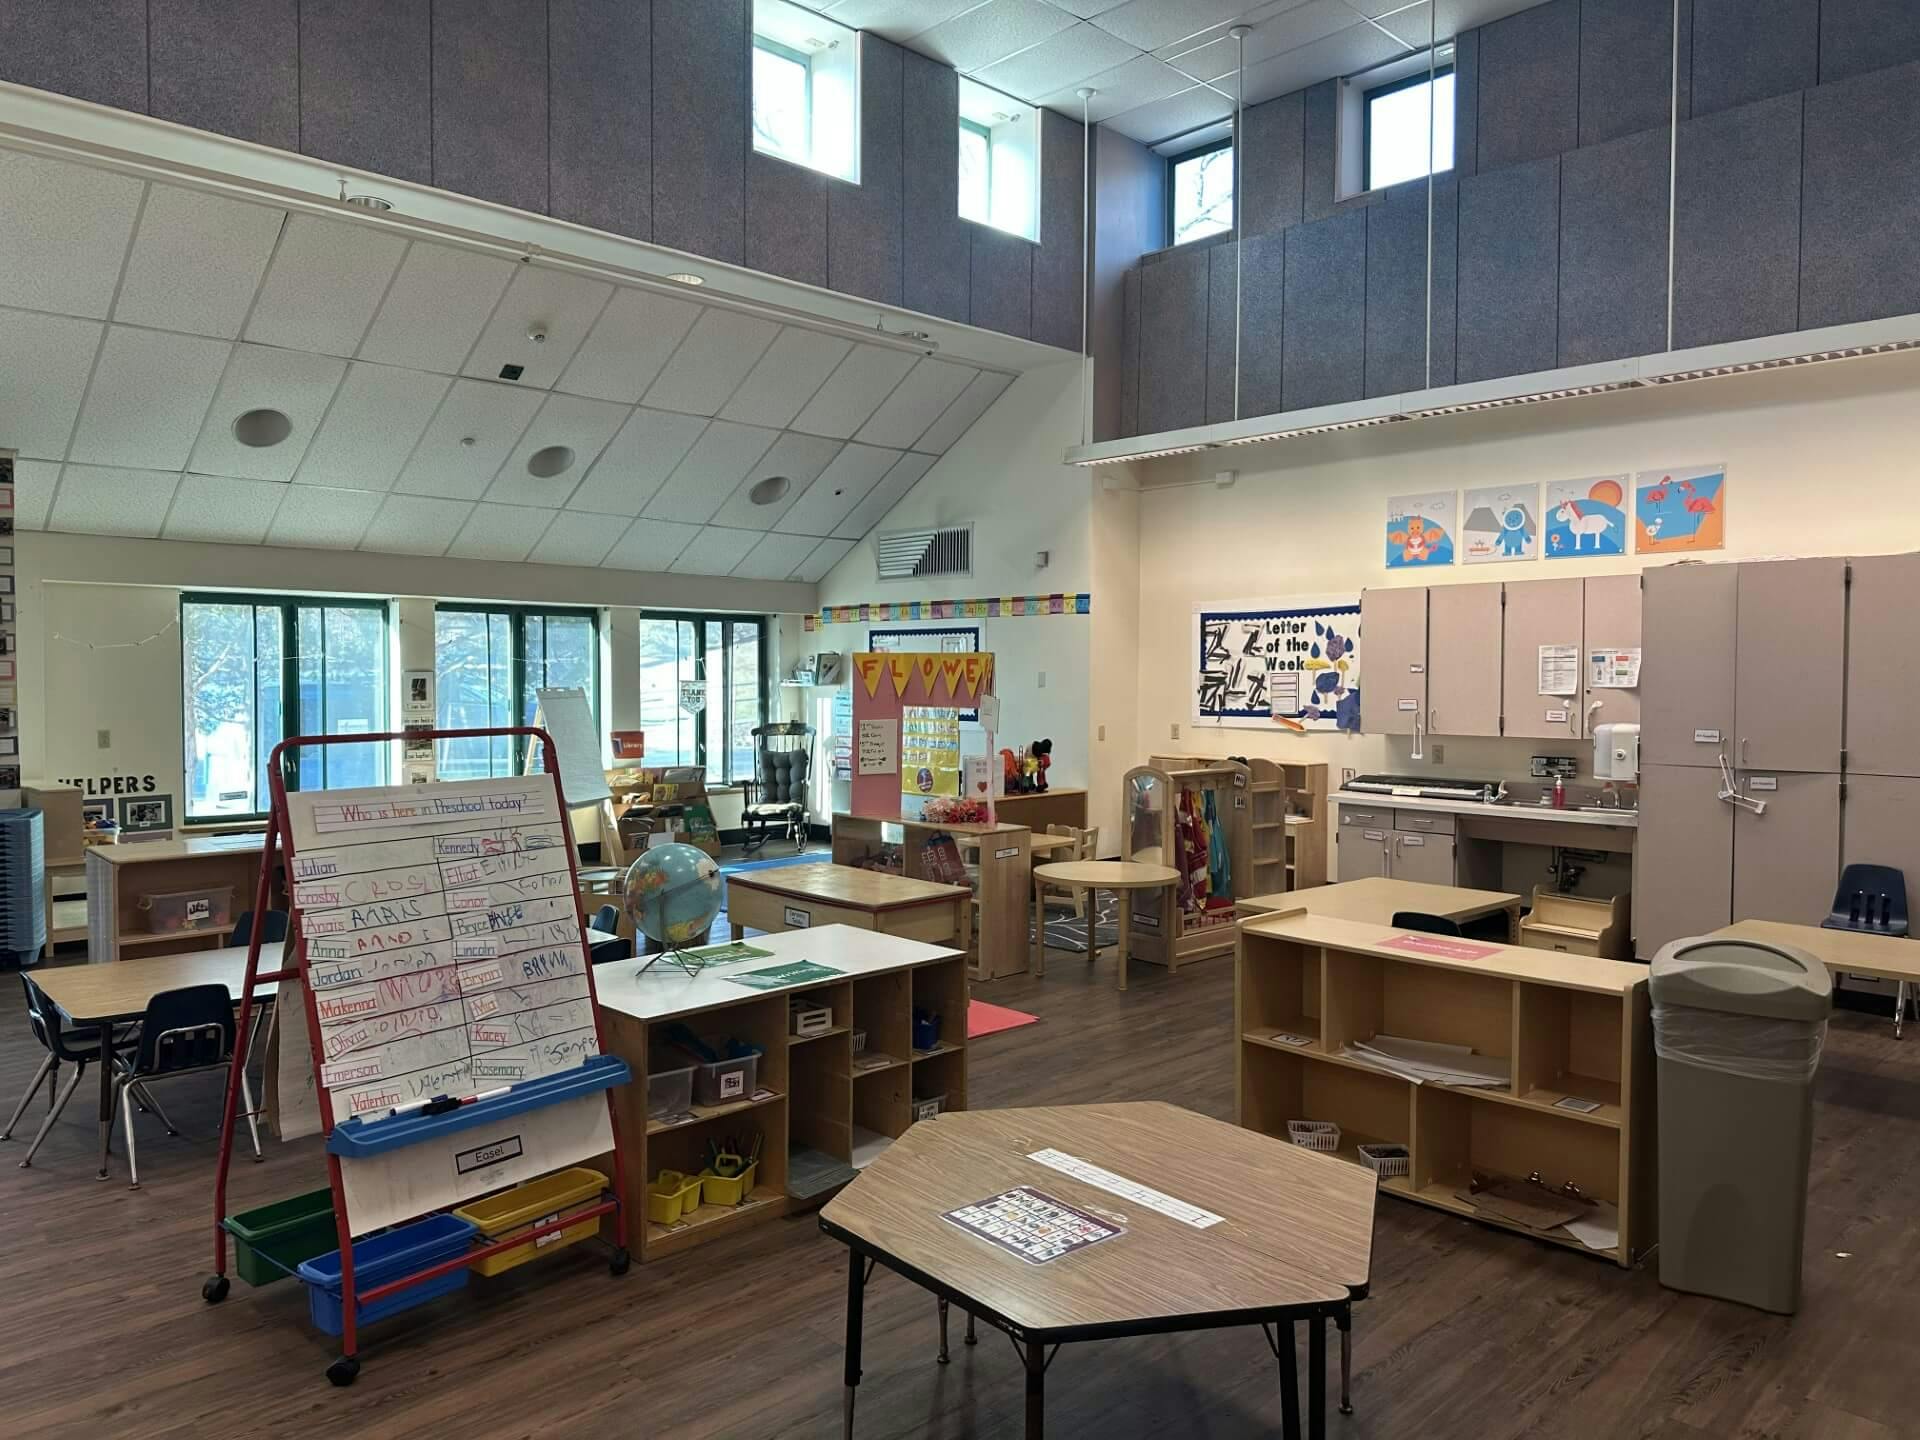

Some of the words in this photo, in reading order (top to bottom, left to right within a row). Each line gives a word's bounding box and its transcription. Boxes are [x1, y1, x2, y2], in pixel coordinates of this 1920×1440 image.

[1266, 620, 1307, 635] Letter
[1266, 637, 1281, 653] of
[1286, 638, 1310, 652] the
[861, 656, 988, 683] FLOWE
[1265, 656, 1306, 671] Week
[341, 804, 371, 822] Who
[379, 809, 389, 819] is
[391, 801, 417, 818] here
[420, 806, 431, 817] in
[433, 796, 485, 815] Preschool
[489, 793, 528, 812] today?
[437, 837, 480, 857] Kennedy
[298, 857, 337, 877] Julian
[296, 885, 340, 905] Crosby
[456, 918, 490, 936] Bryce
[311, 939, 346, 958] Anna
[455, 940, 496, 957] Lincoln
[312, 964, 363, 987] Jordan
[320, 997, 378, 1019] Makenna
[330, 1029, 369, 1054] Olivia
[475, 1024, 507, 1046] Kacey
[325, 1062, 380, 1085] Emerson
[476, 1058, 525, 1080] Rosemary
[351, 1088, 401, 1112] Valentin
[475, 1145, 505, 1163] Easel
